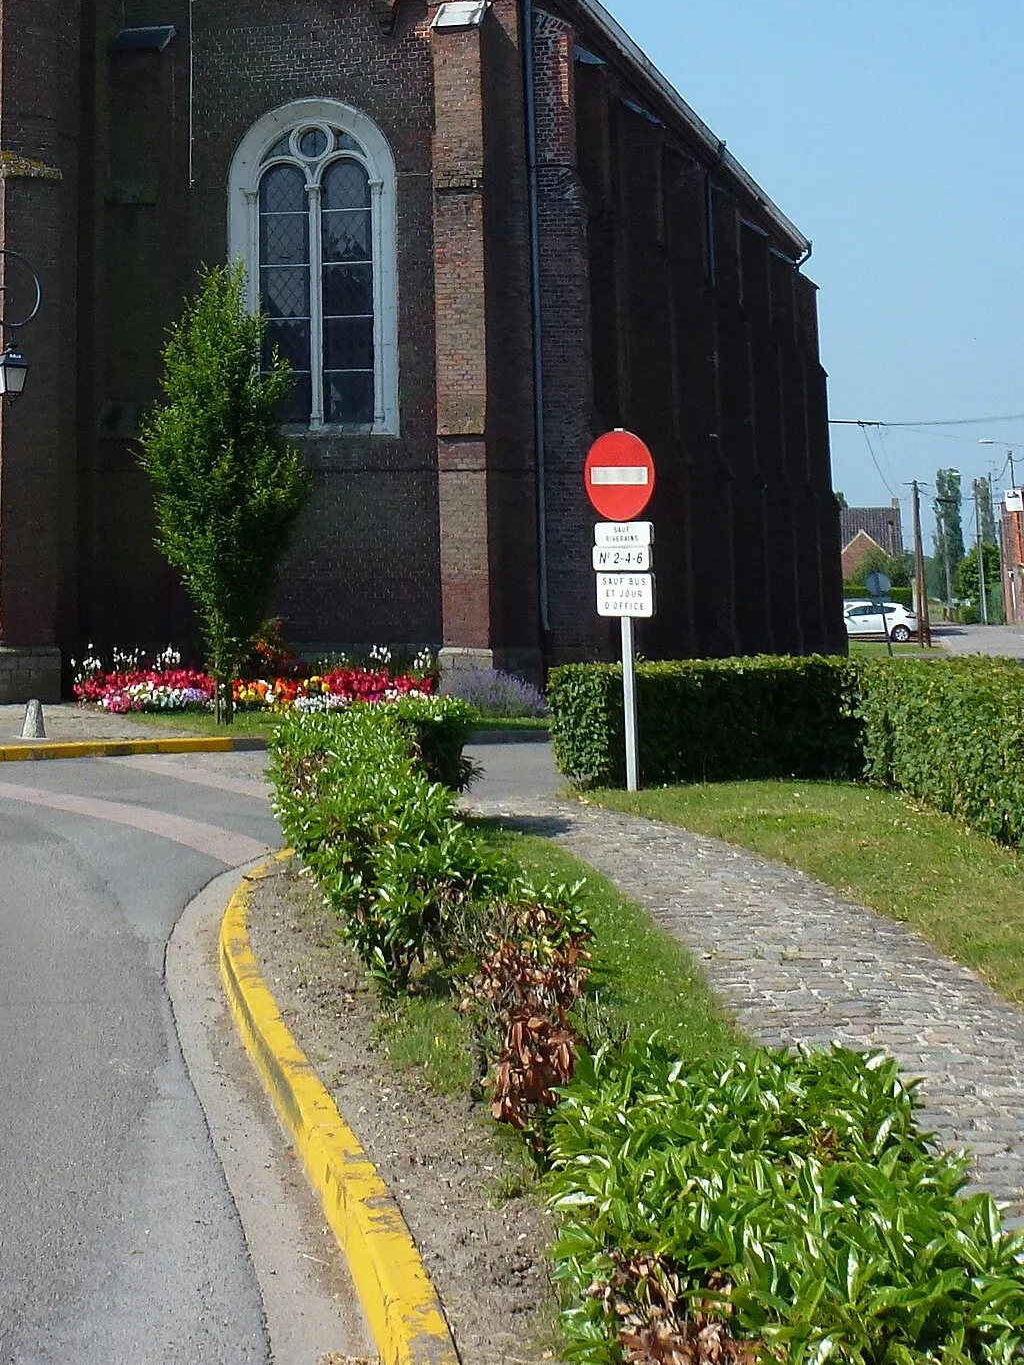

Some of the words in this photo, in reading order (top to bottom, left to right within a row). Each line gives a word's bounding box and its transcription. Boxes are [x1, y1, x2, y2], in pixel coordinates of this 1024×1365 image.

[613, 552, 643, 564] 2-4-6
[602, 577, 624, 585] SAUF
[629, 577, 646, 585] BUS
[619, 590, 642, 598] JOUR
